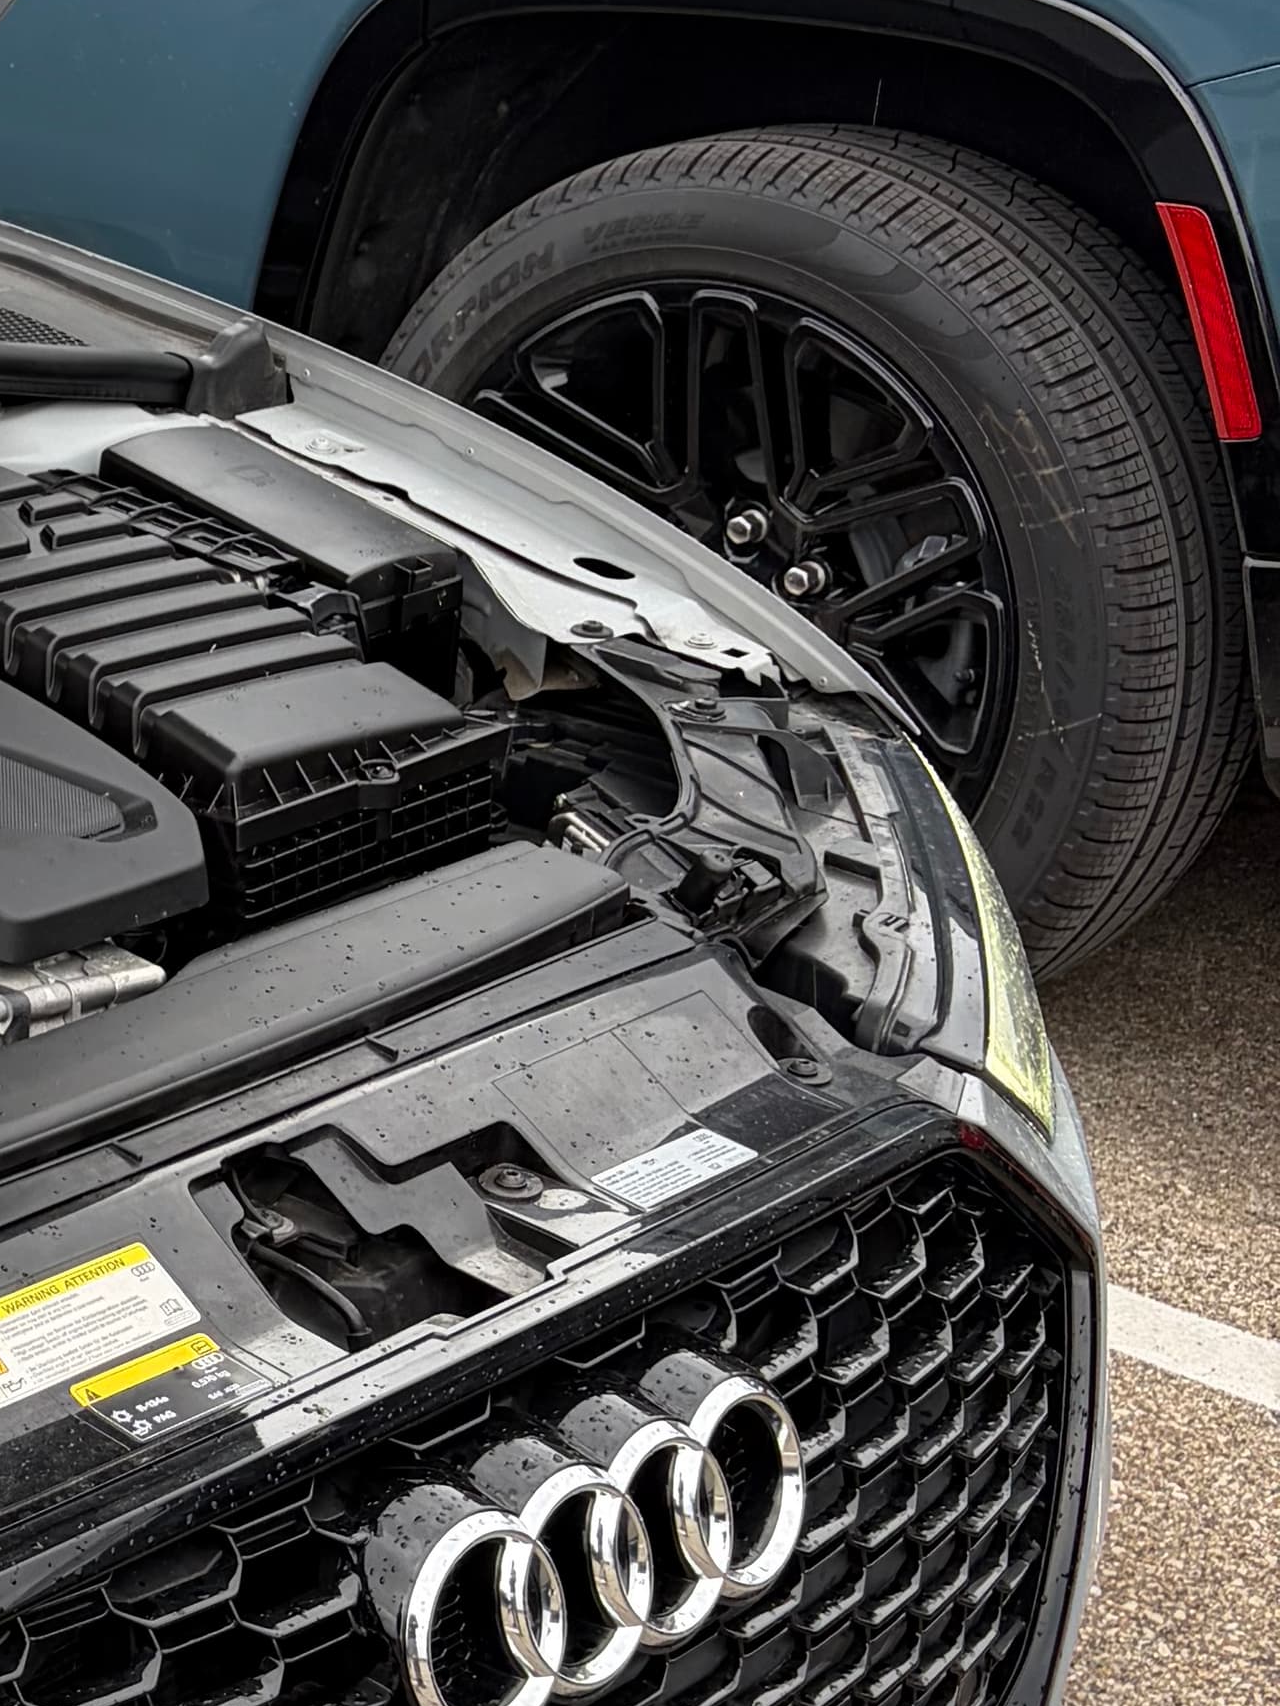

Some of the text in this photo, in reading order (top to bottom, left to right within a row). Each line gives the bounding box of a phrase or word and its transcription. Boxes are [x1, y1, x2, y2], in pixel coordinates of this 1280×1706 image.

[407, 242, 556, 388] ORPION
[2, 1284, 60, 1315] WARNING
[64, 1257, 126, 1290] ATTENTION
